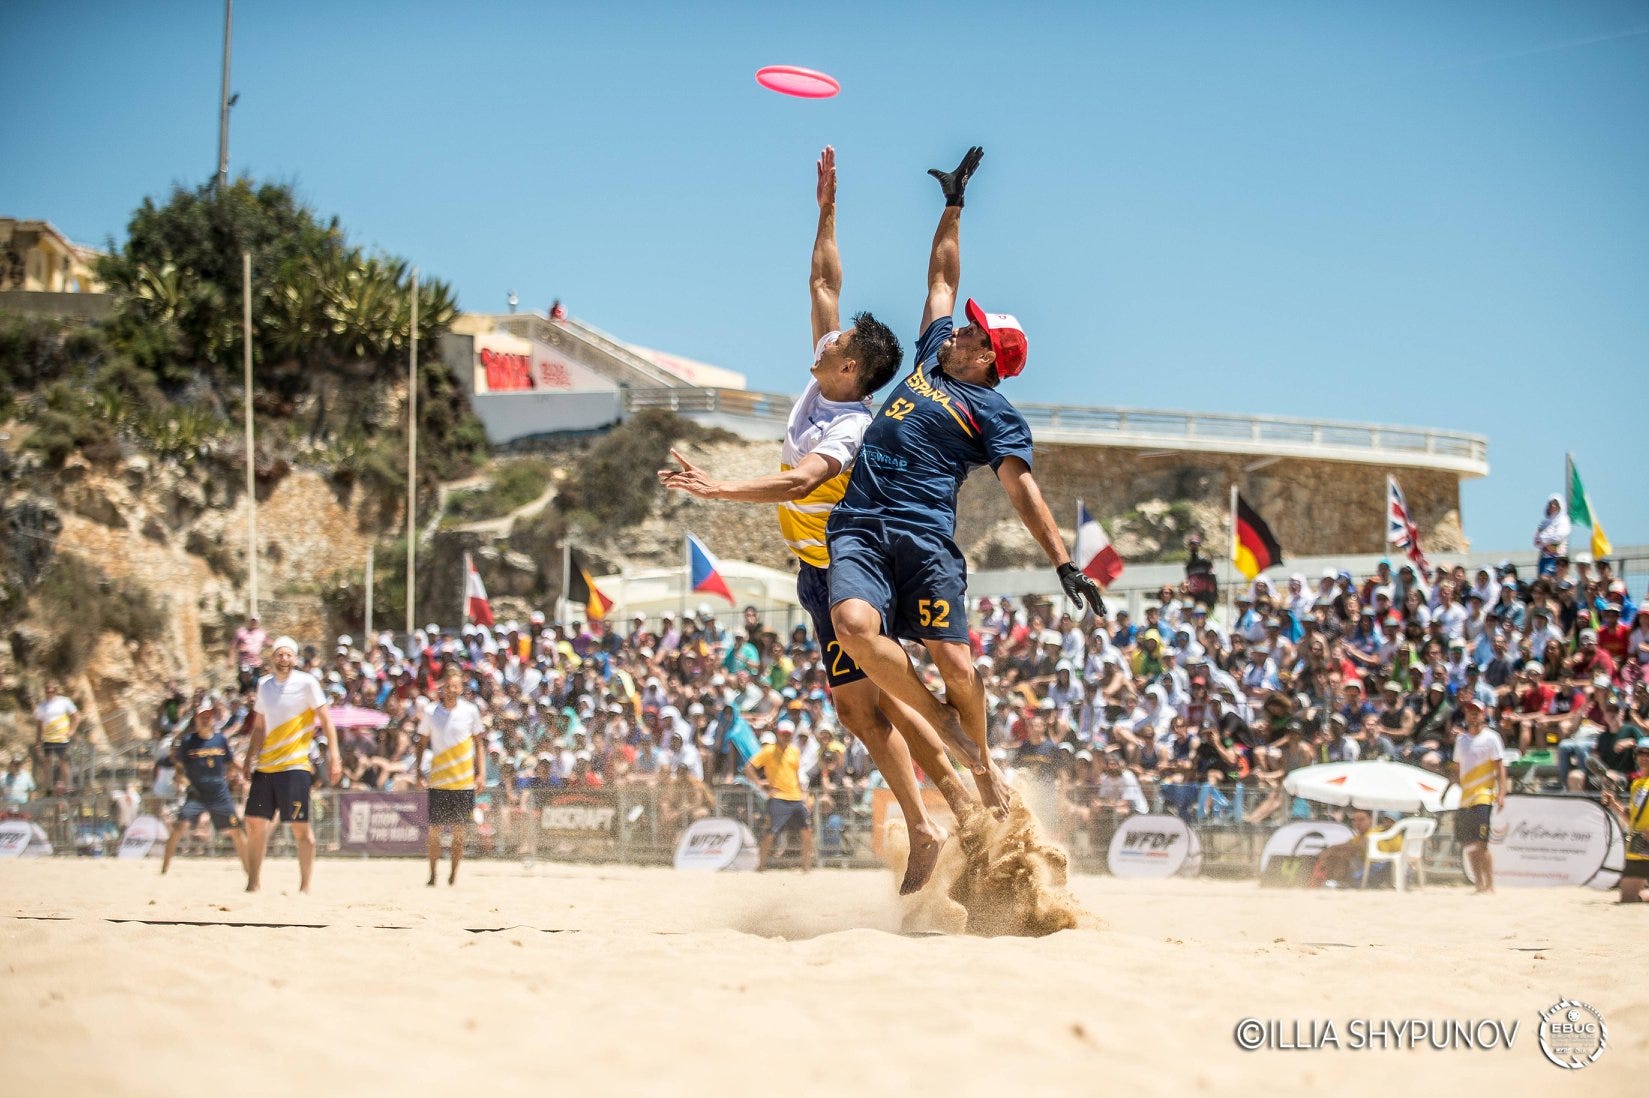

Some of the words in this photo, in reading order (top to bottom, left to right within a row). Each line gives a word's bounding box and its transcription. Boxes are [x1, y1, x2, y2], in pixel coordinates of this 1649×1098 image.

[885, 397, 915, 421] 52
[918, 599, 950, 628] 52
[827, 640, 860, 677] 2
[291, 801, 302, 821] 7
[1123, 831, 1182, 849] WFDF
